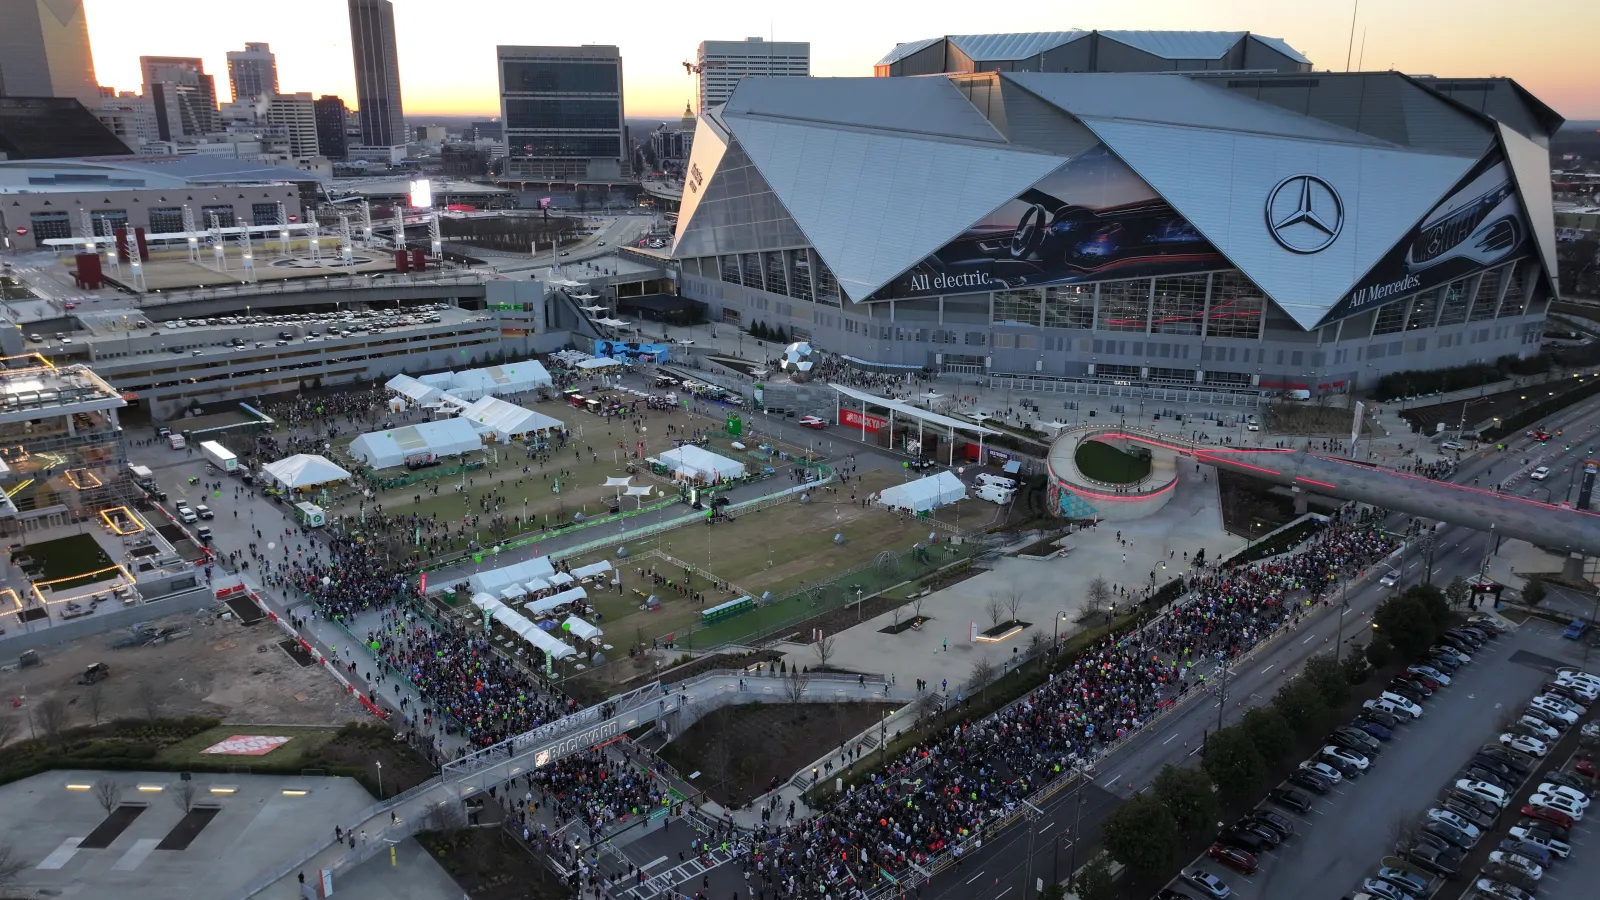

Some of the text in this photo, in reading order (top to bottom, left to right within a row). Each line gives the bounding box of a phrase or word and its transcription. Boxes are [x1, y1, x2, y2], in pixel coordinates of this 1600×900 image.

[910, 270, 993, 291] All electric.
[1348, 274, 1421, 309] All Mercedes.
[548, 720, 618, 759] BACKYARD
